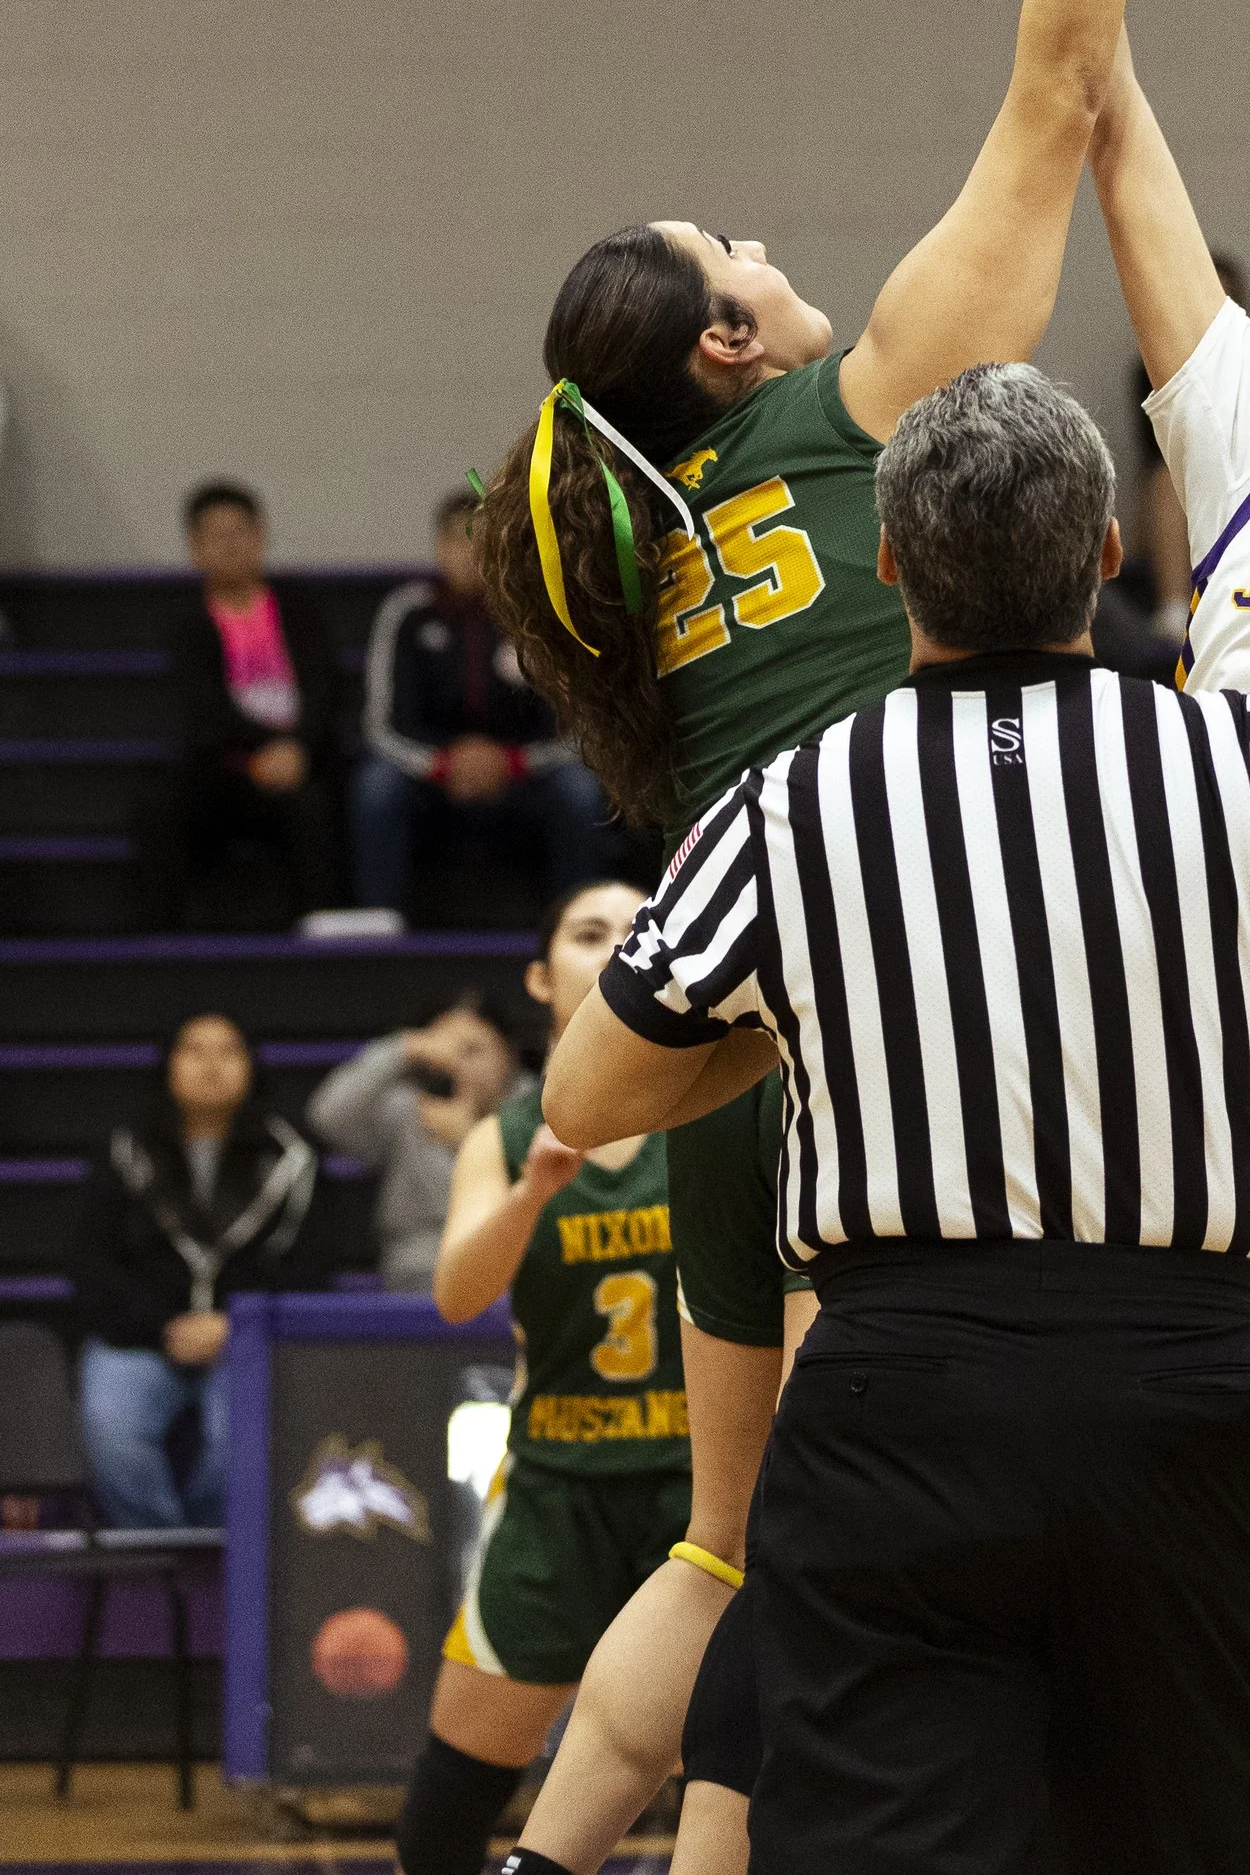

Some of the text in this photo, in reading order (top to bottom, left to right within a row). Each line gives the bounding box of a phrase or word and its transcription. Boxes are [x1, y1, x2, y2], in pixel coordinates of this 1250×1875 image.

[656, 474, 828, 681] 25
[992, 753, 1024, 766] USA
[591, 1269, 658, 1383] 3
